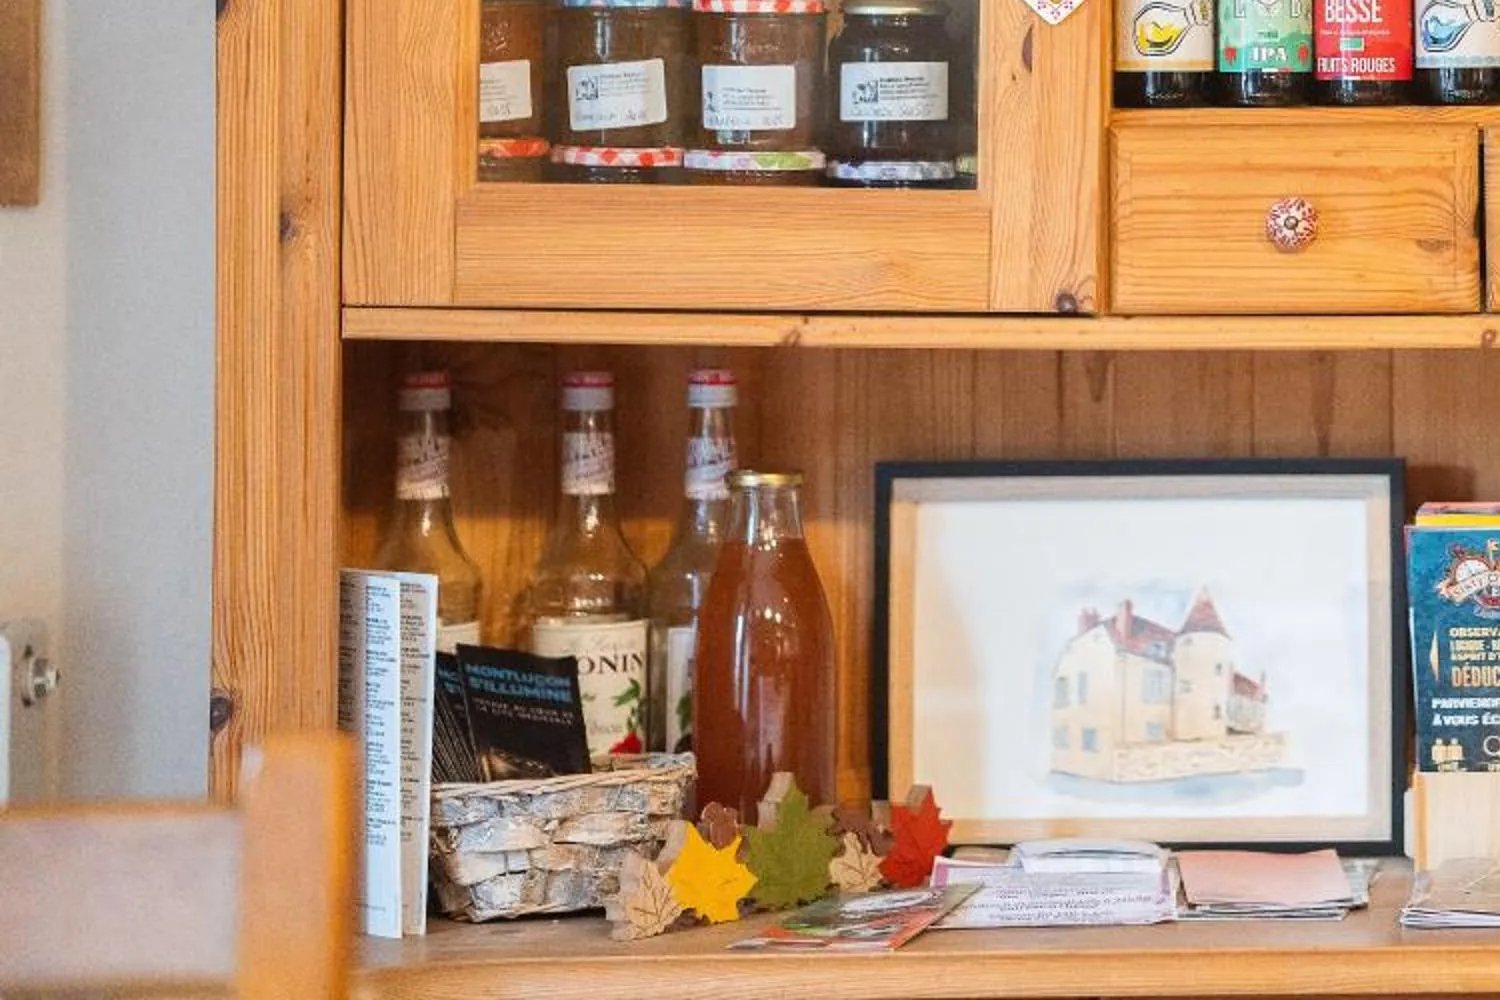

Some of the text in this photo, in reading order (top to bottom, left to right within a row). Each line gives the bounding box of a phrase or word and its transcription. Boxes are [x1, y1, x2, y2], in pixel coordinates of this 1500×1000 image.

[1252, 46, 1287, 61] IPA
[1351, 57, 1396, 73] ROUGES
[577, 653, 643, 674] ONIN
